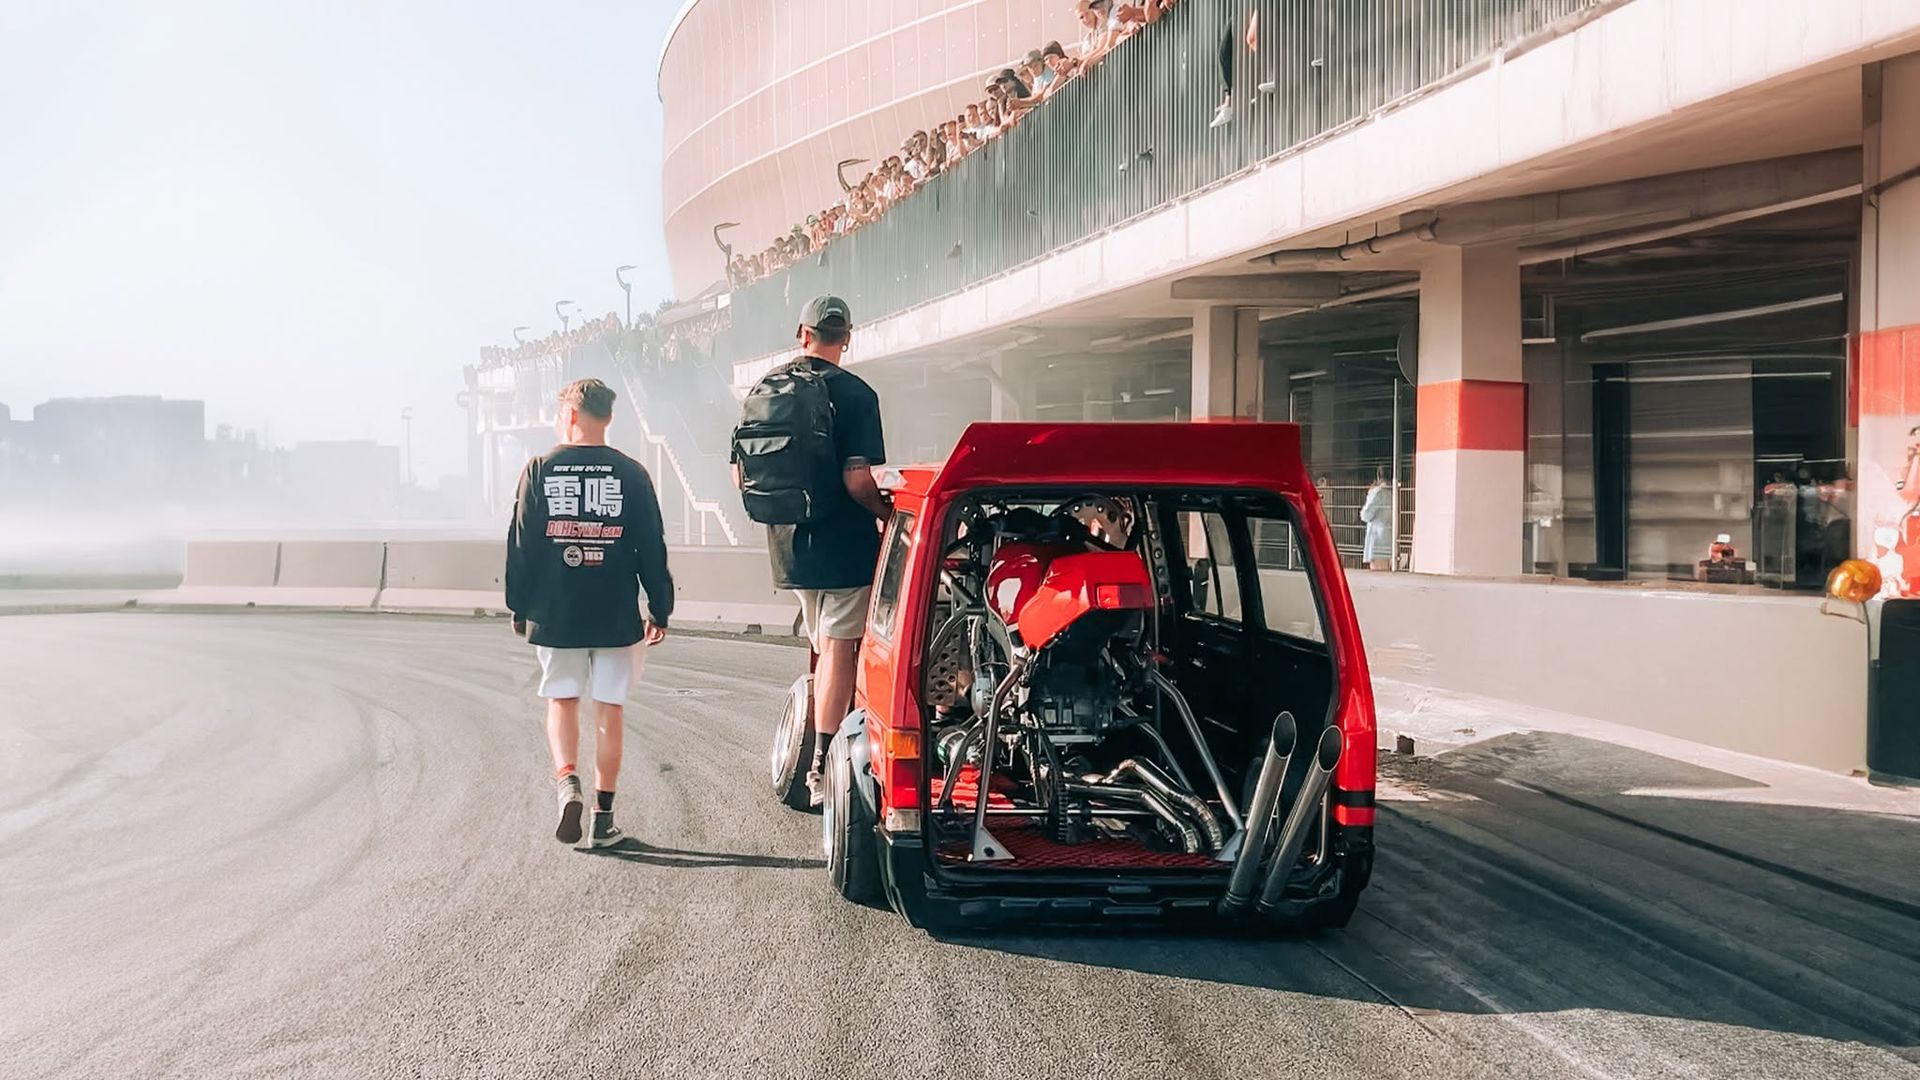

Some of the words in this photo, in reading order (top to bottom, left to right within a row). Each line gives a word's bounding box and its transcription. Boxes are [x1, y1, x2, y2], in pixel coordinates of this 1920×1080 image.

[543, 475, 624, 518] 雷鳴
[546, 520, 579, 537] DOHC
[601, 526, 624, 538] CAM
